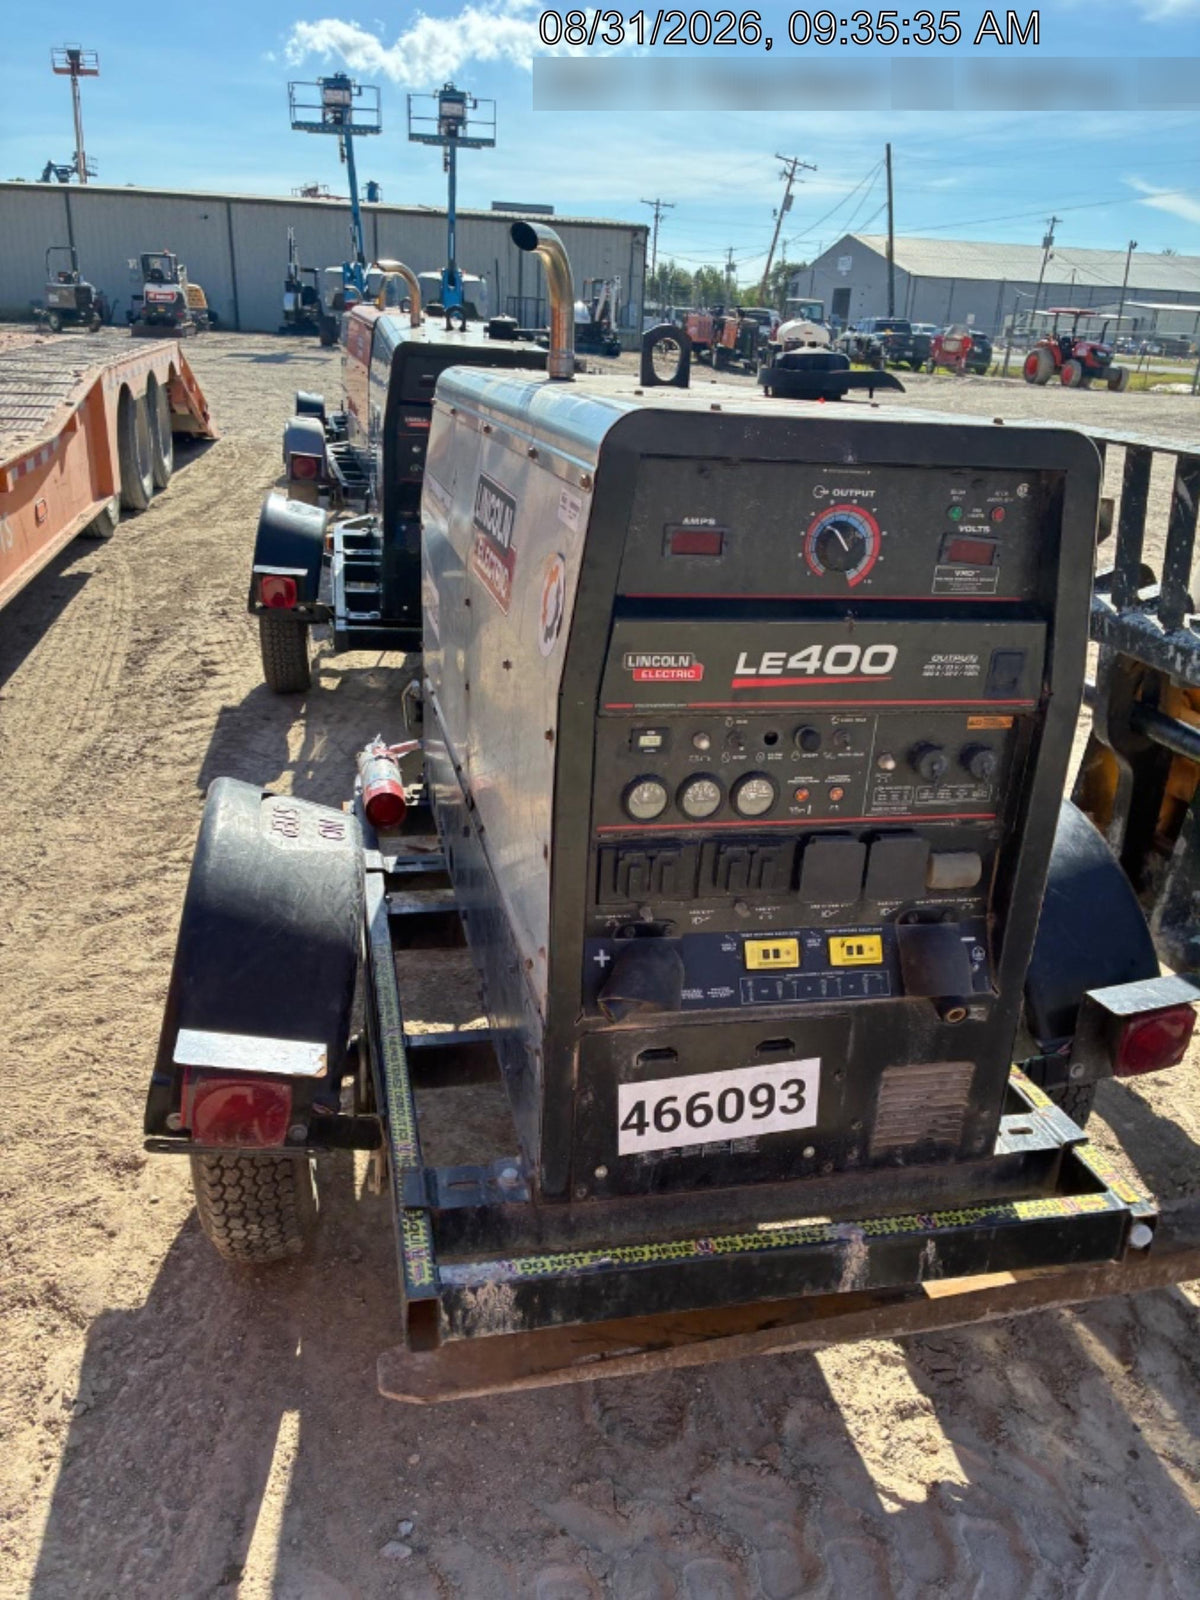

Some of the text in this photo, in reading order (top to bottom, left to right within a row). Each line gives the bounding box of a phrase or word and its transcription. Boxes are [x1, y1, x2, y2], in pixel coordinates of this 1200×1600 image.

[832, 488, 877, 498] OUTPUT
[474, 482, 514, 549] LINCOLN
[682, 516, 716, 526] AMPS
[958, 525, 991, 534] VOLTS
[627, 655, 690, 668] LINCOLN
[734, 644, 899, 675] LE400
[641, 669, 696, 679] ELECTRIC
[619, 1078, 807, 1137] 466093
[520, 1261, 545, 1271] DO
[550, 1256, 586, 1268] NOT
[590, 1249, 646, 1263] SAND
[650, 1243, 693, 1256] HERE
